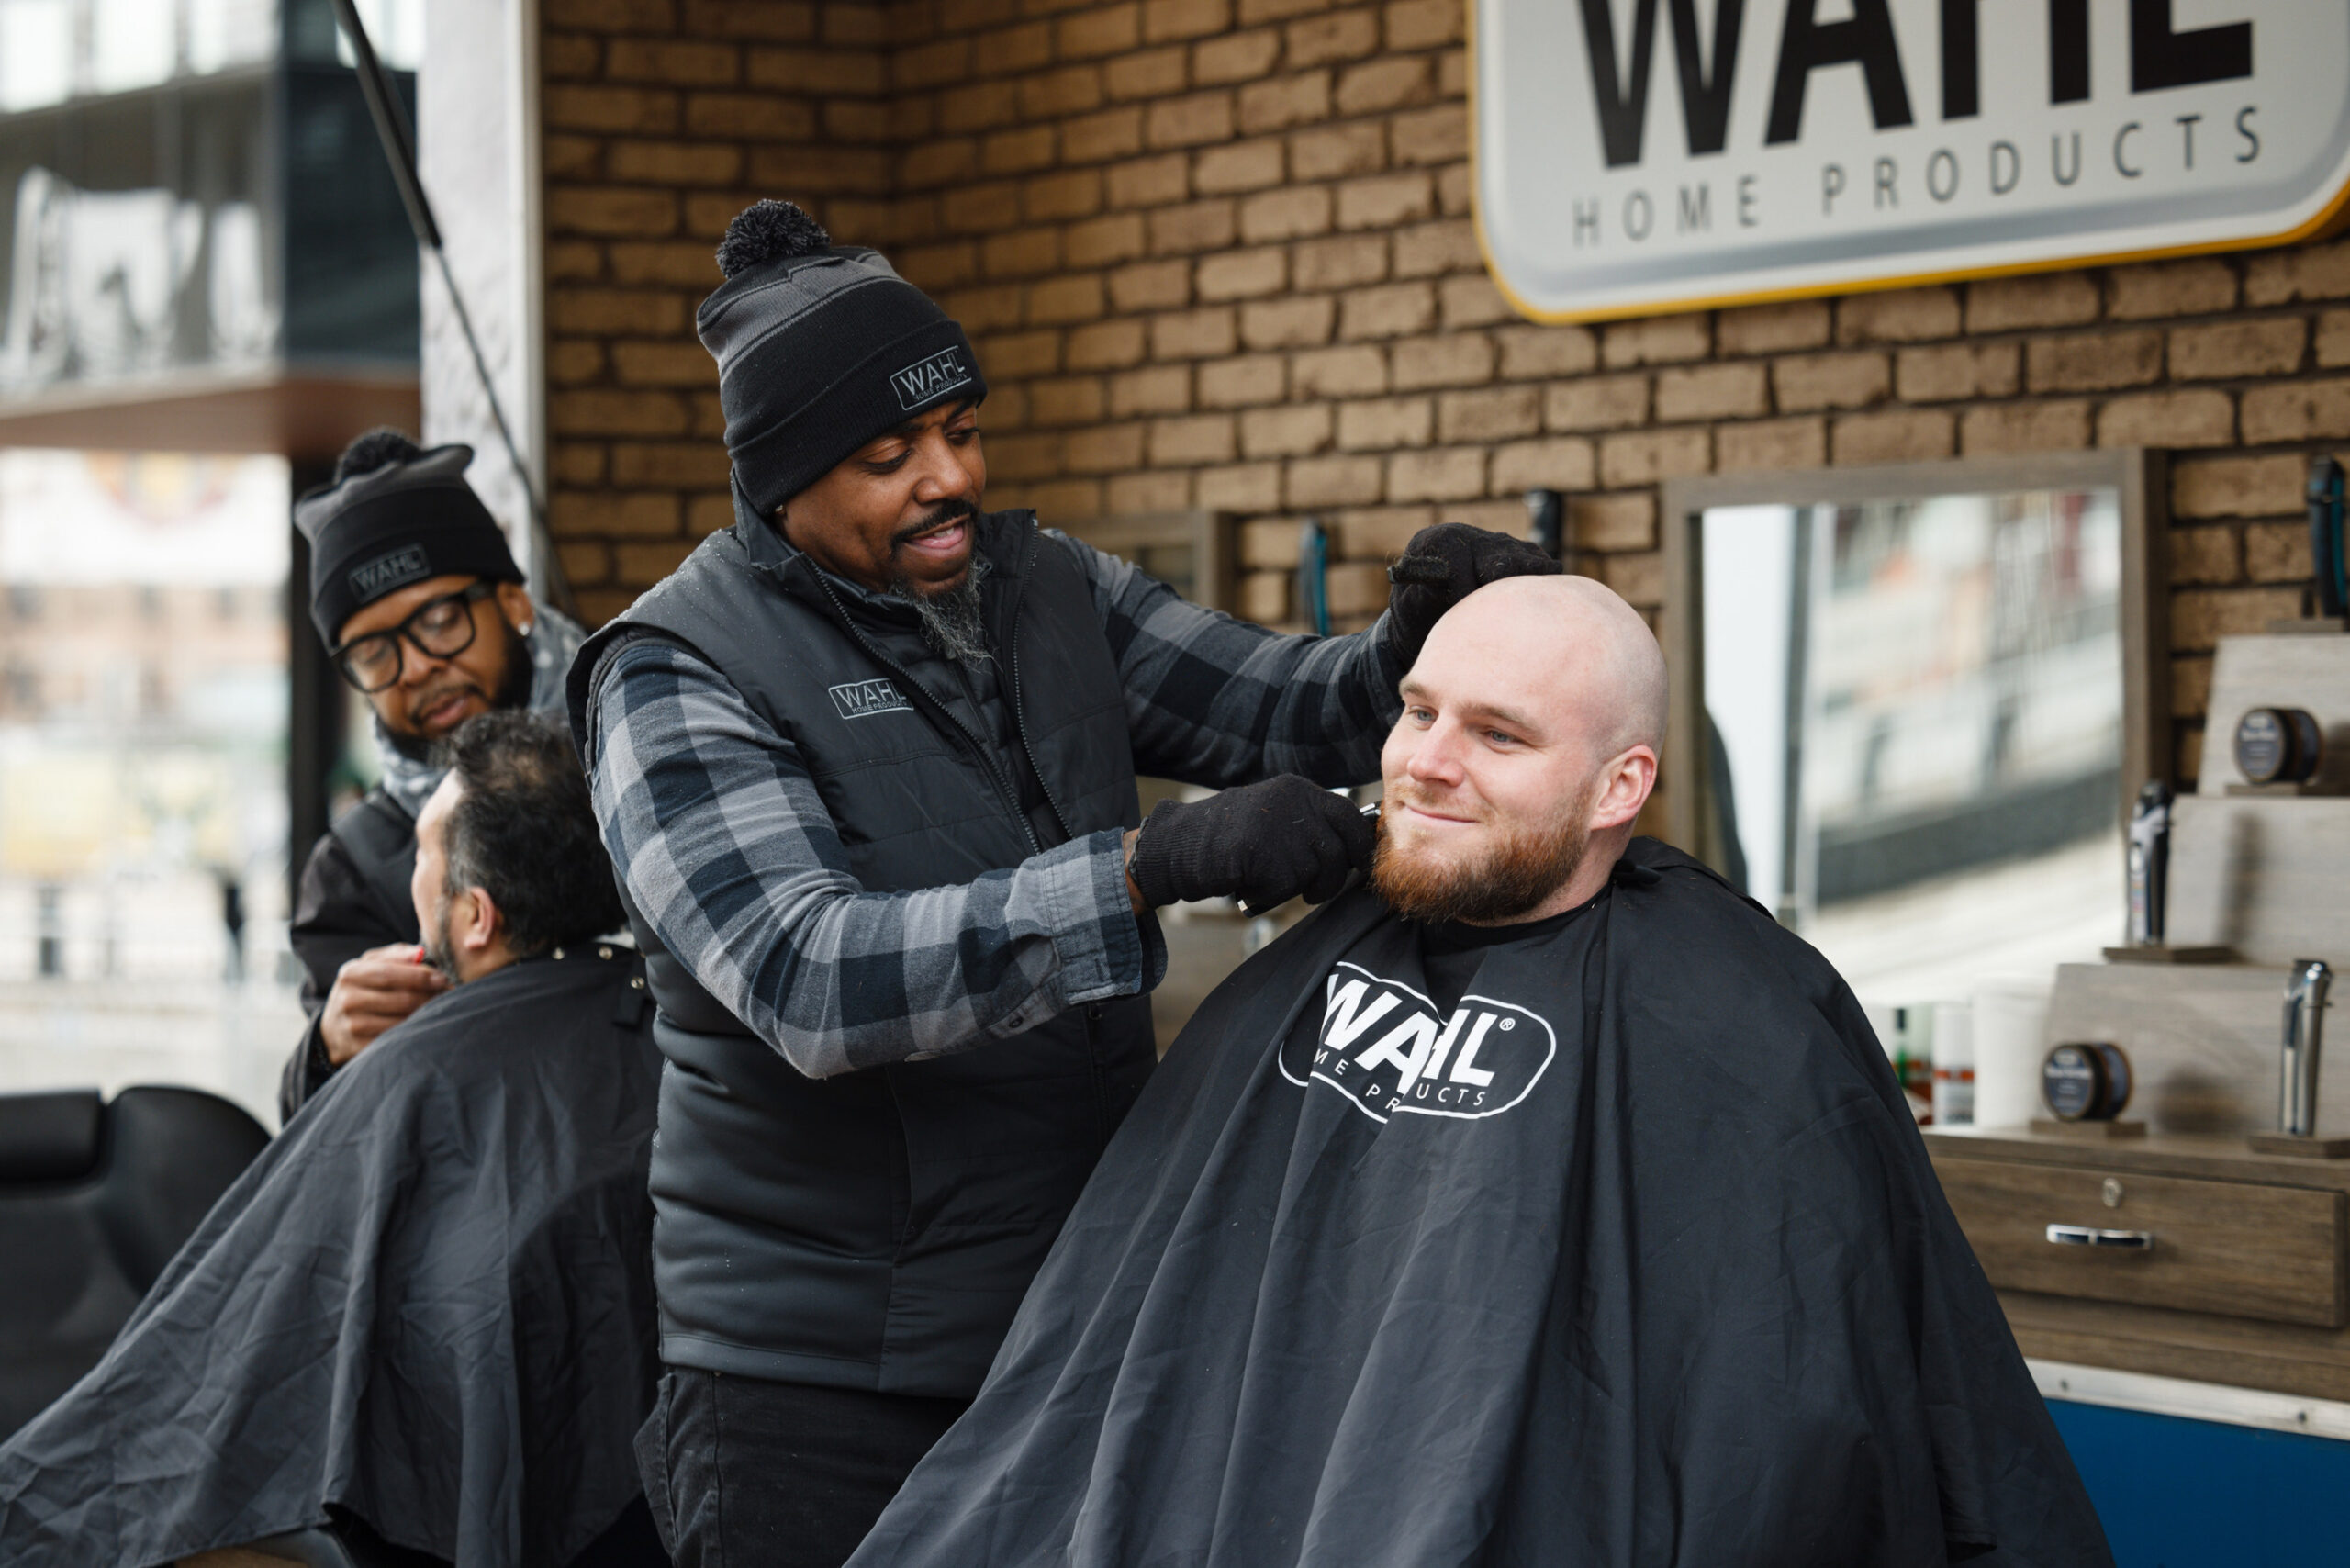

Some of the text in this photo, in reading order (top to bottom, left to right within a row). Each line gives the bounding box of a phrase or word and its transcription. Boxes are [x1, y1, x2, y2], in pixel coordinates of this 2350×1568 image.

[1574, 106, 2262, 246] HOME PRODUCTS
[899, 353, 966, 396] WAHL
[836, 682, 907, 708] WAHL
[852, 705, 873, 713] HOME
[1313, 1048, 1486, 1111] ME PRUCTS
